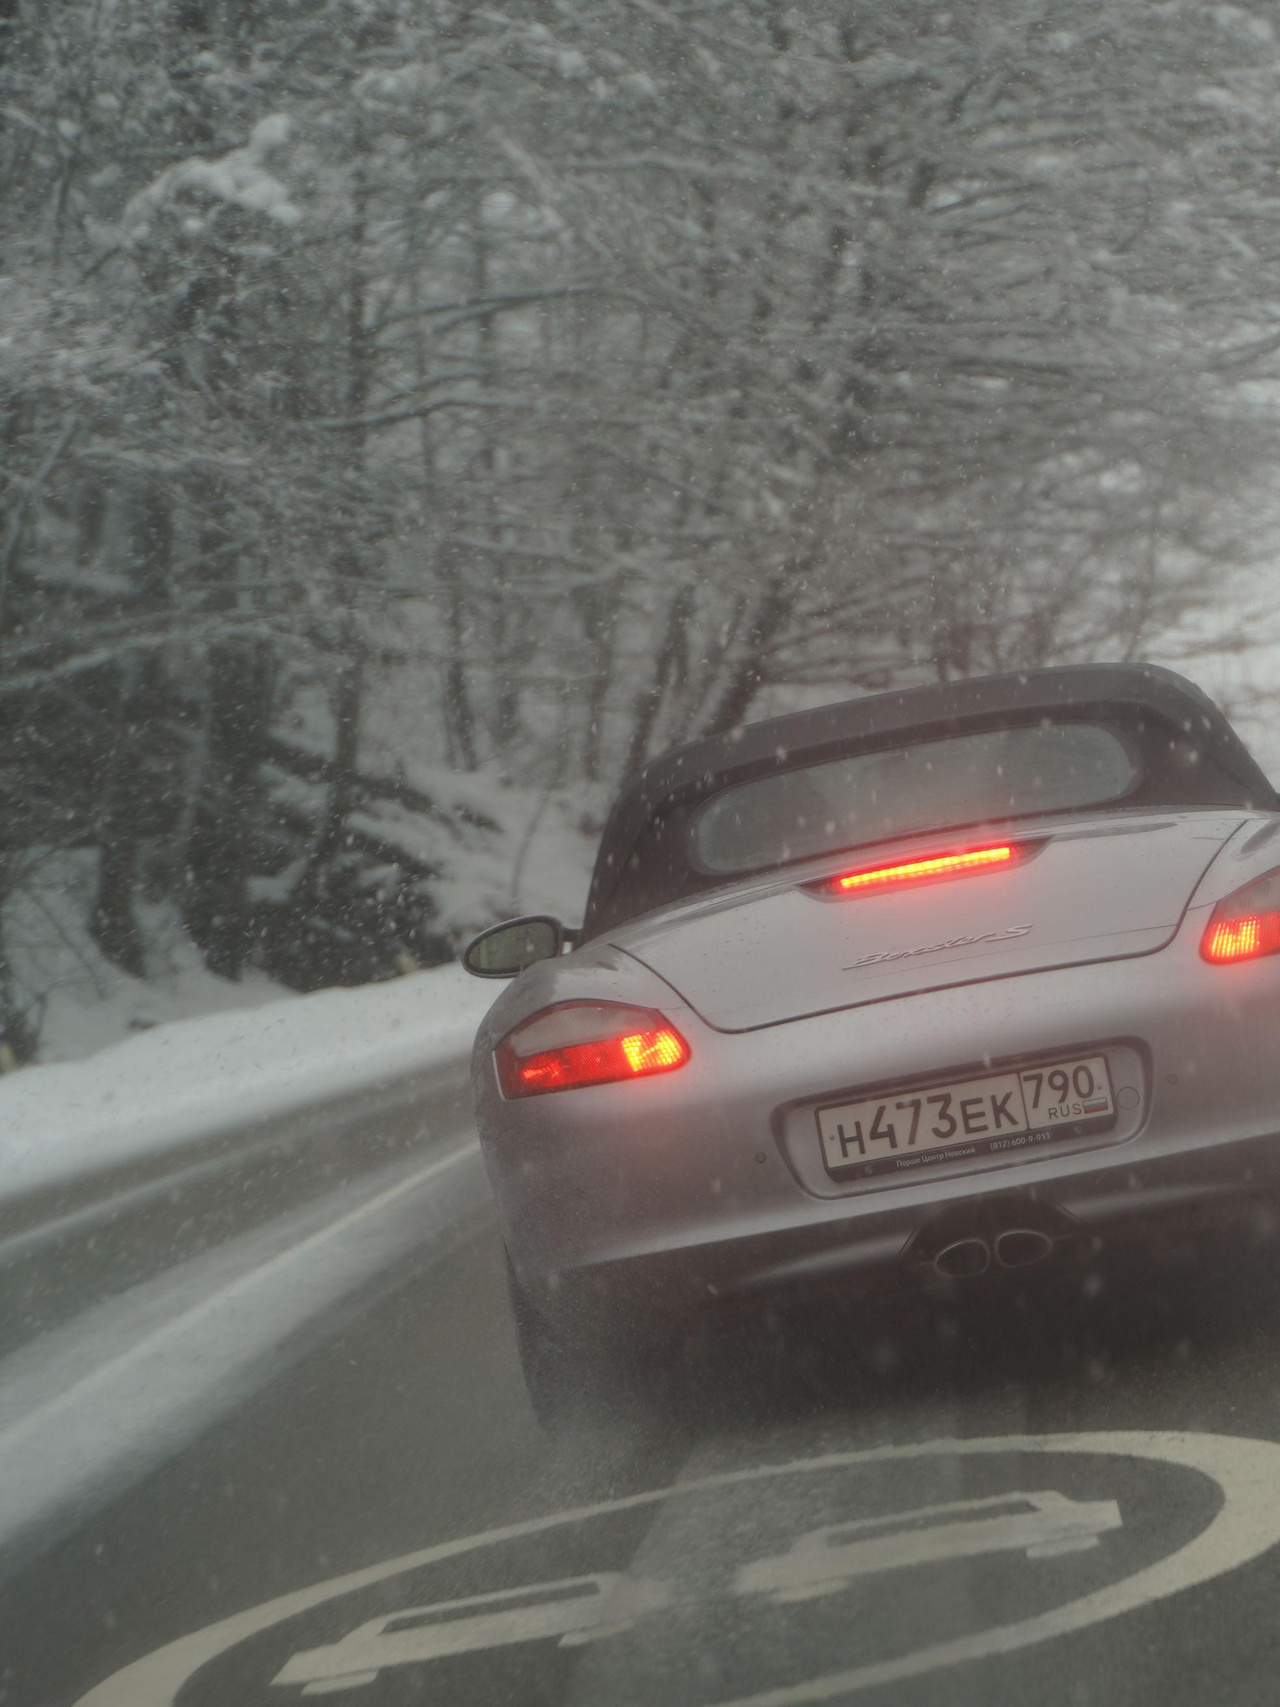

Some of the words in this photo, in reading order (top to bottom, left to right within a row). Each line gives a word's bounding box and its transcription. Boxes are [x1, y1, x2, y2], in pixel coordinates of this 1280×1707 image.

[985, 923, 1033, 944] S
[1023, 1065, 1095, 1109] 790
[1048, 1102, 1082, 1121] RUS
[990, 1139, 1011, 1151] (812)
